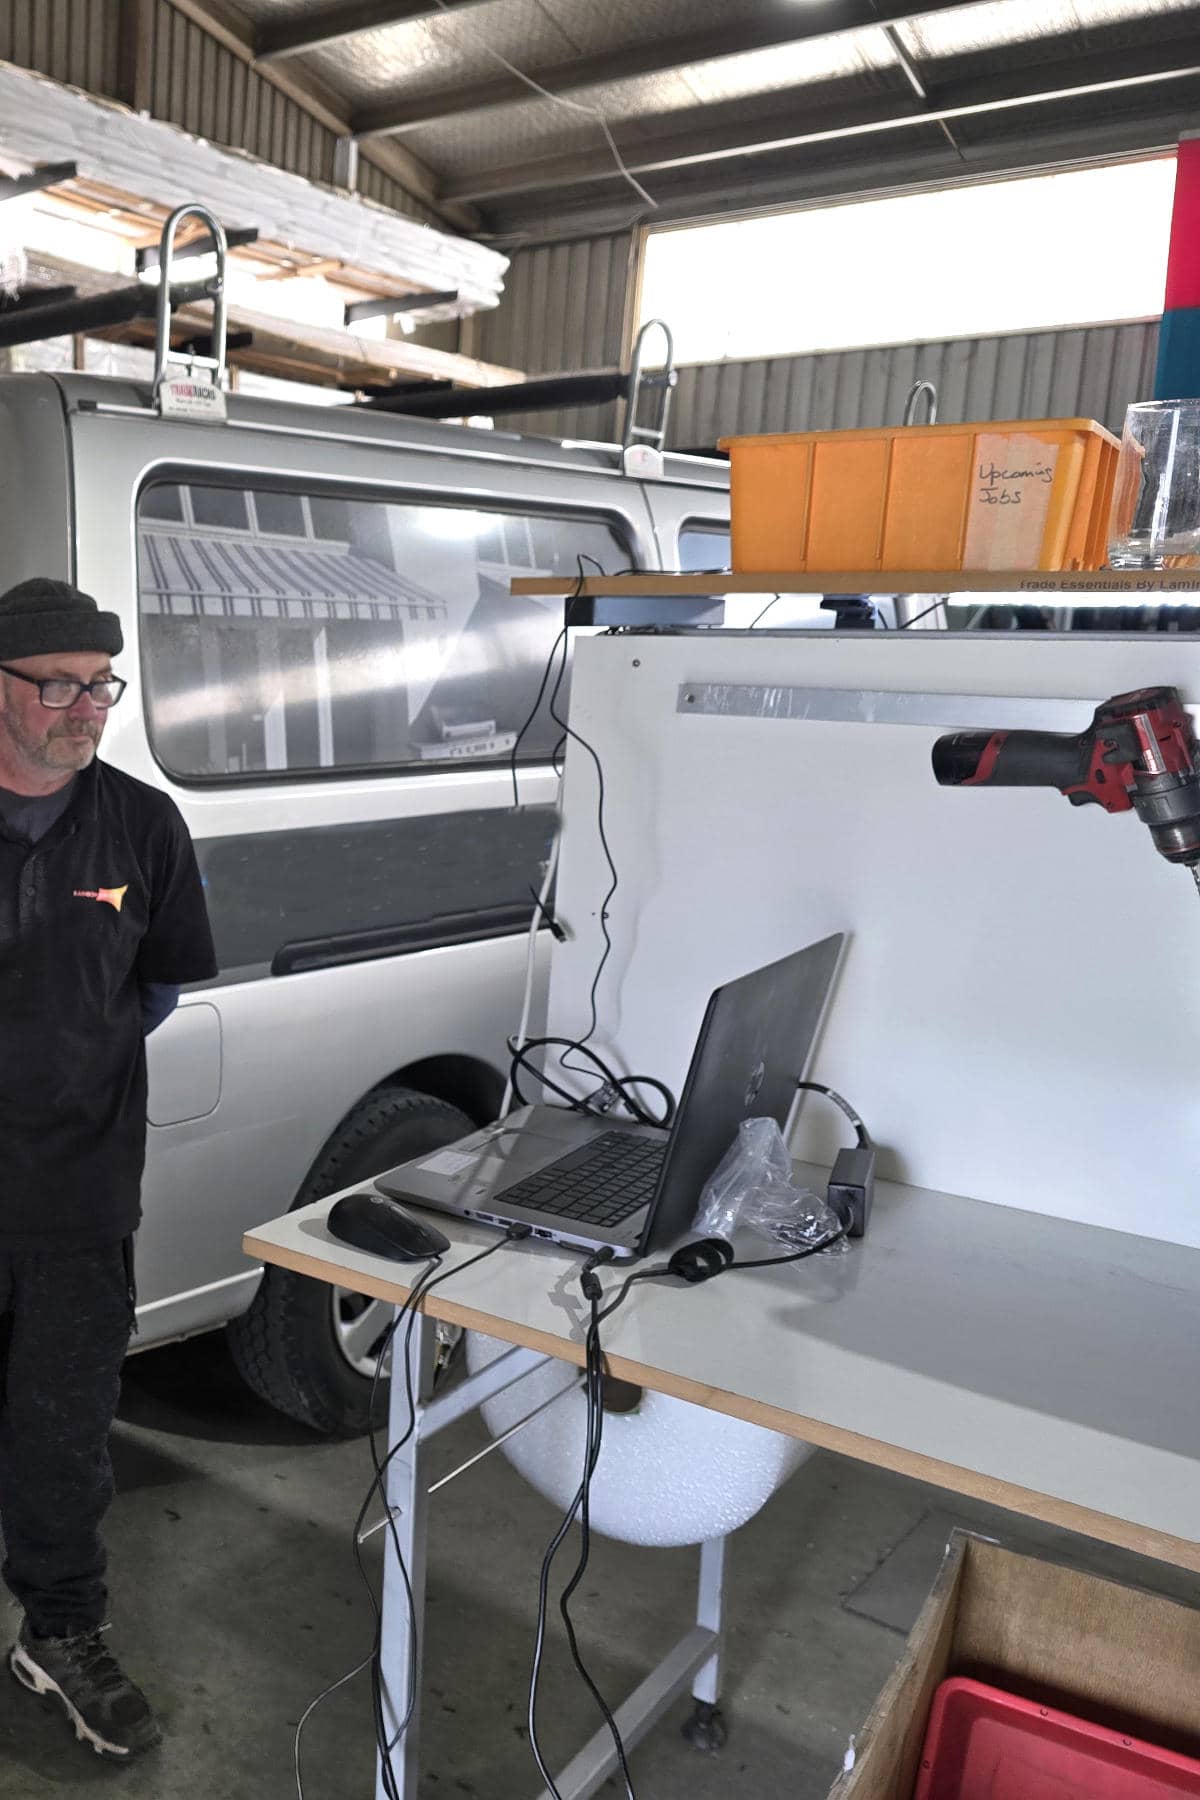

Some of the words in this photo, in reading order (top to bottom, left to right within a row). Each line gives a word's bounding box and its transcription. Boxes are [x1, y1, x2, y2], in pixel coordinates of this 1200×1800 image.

[979, 462, 1053, 486] Upcoming
[979, 487, 1021, 504] Jobs
[1020, 579, 1056, 590] Trade
[1060, 579, 1131, 590] Essentials
